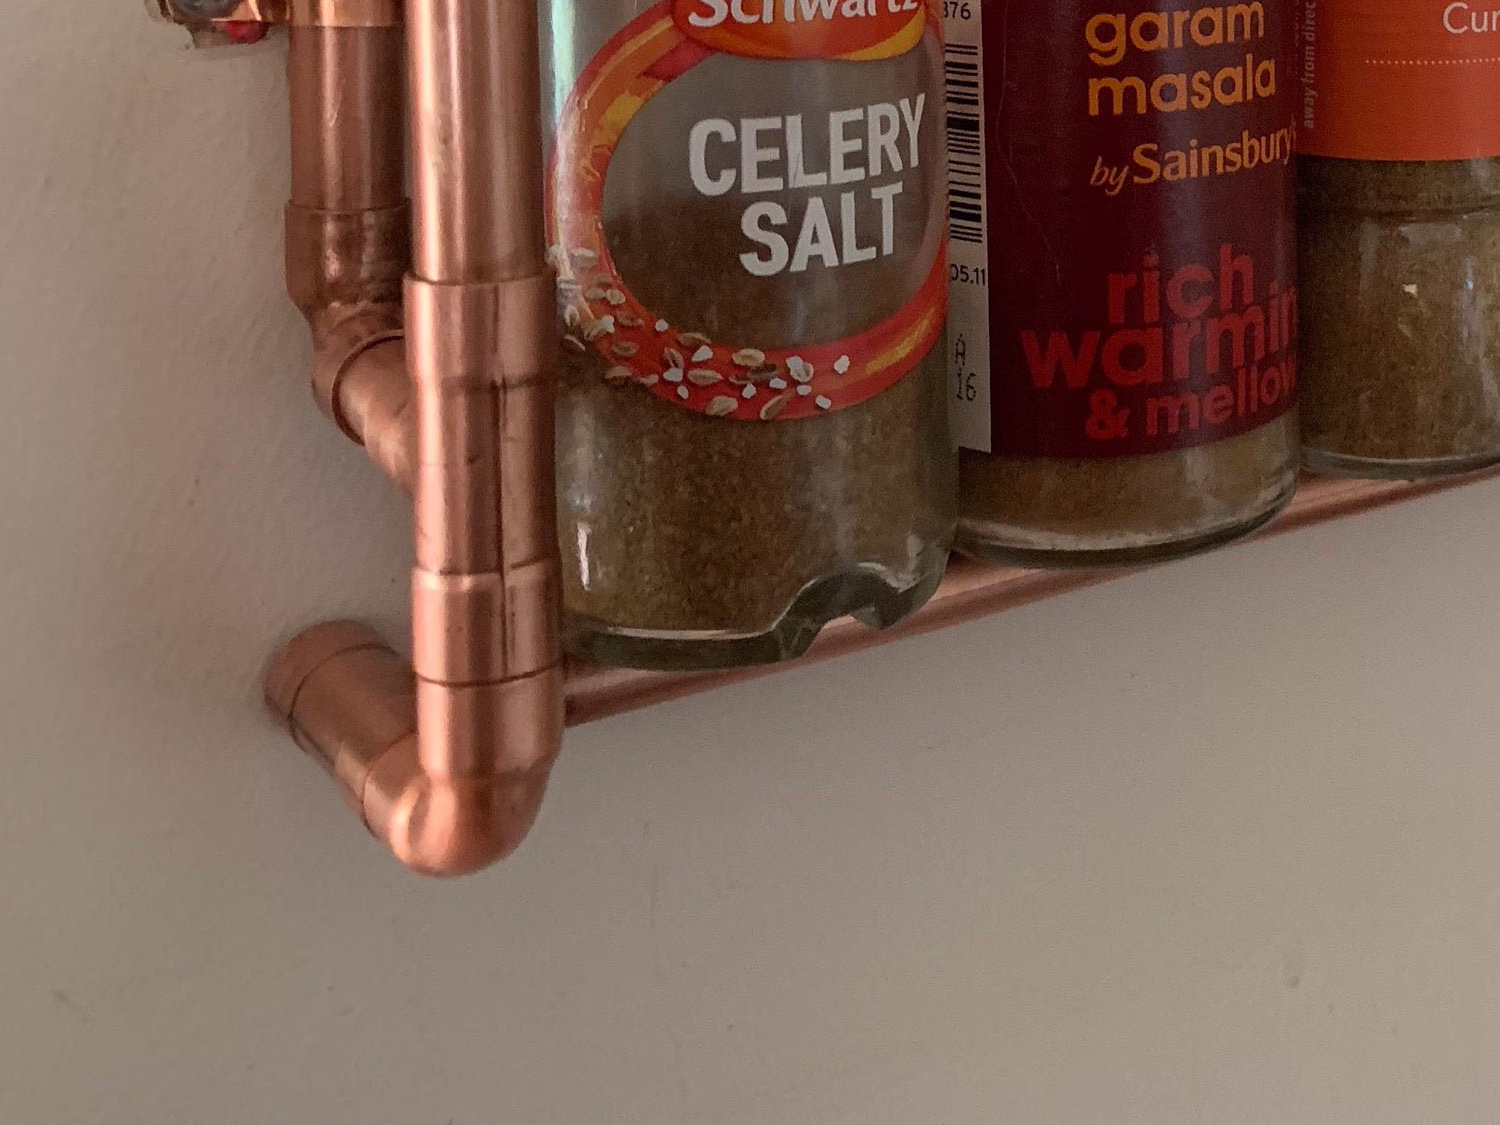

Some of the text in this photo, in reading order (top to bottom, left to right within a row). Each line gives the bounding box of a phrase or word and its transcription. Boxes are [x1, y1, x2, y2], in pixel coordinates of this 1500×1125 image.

[1085, 0, 1265, 66] garam
[1087, 54, 1276, 115] masala
[1303, 46, 1315, 84] from
[1304, 85, 1318, 129] away
[688, 93, 926, 196] CELERY
[1090, 156, 1130, 197] by
[739, 182, 903, 276] SALT
[1107, 243, 1254, 324] rich
[1085, 389, 1130, 440] &
